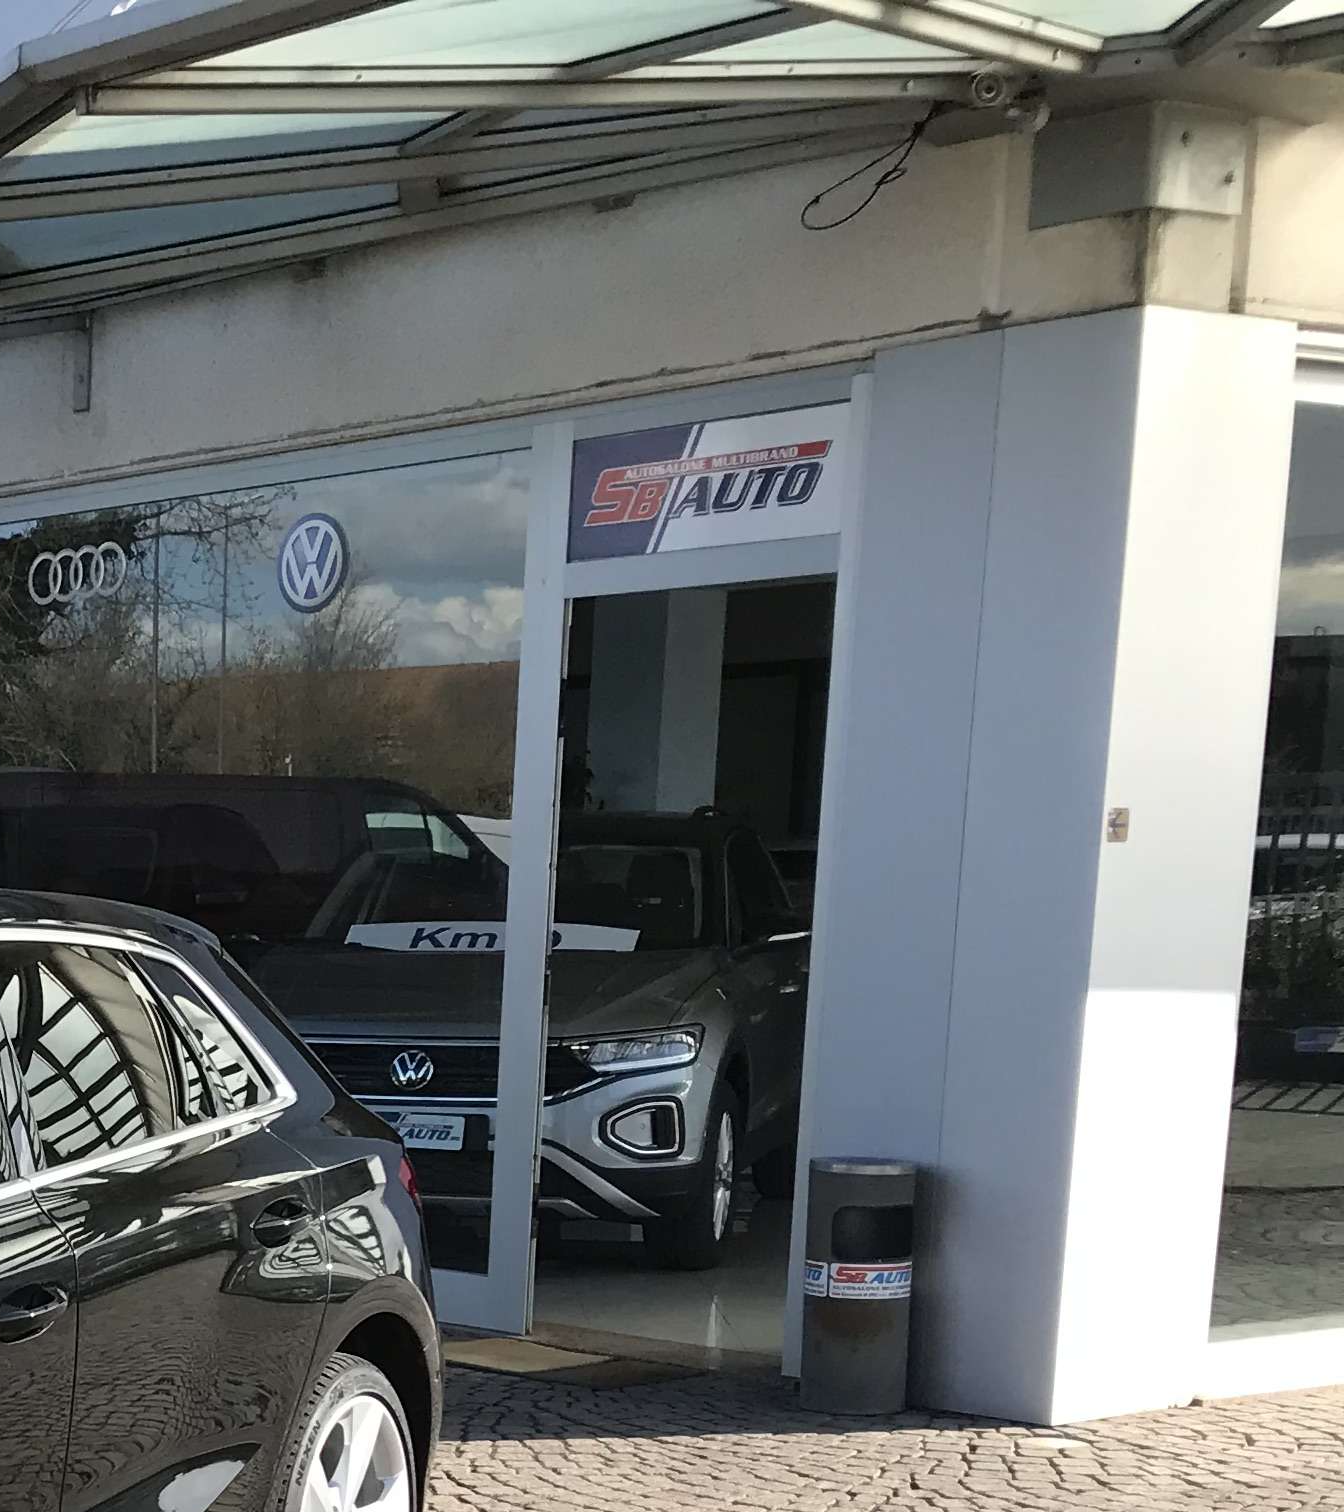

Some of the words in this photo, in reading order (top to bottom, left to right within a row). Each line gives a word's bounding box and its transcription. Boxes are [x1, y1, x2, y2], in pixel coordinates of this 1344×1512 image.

[623, 459, 706, 482] AUTOSALONE
[711, 446, 799, 471] MULTIBRAND
[584, 469, 670, 527] SB
[669, 461, 823, 519] AUTO
[409, 927, 498, 949] Km
[402, 1127, 451, 1141] AUTO
[295, 1419, 321, 1487] NEXEN
